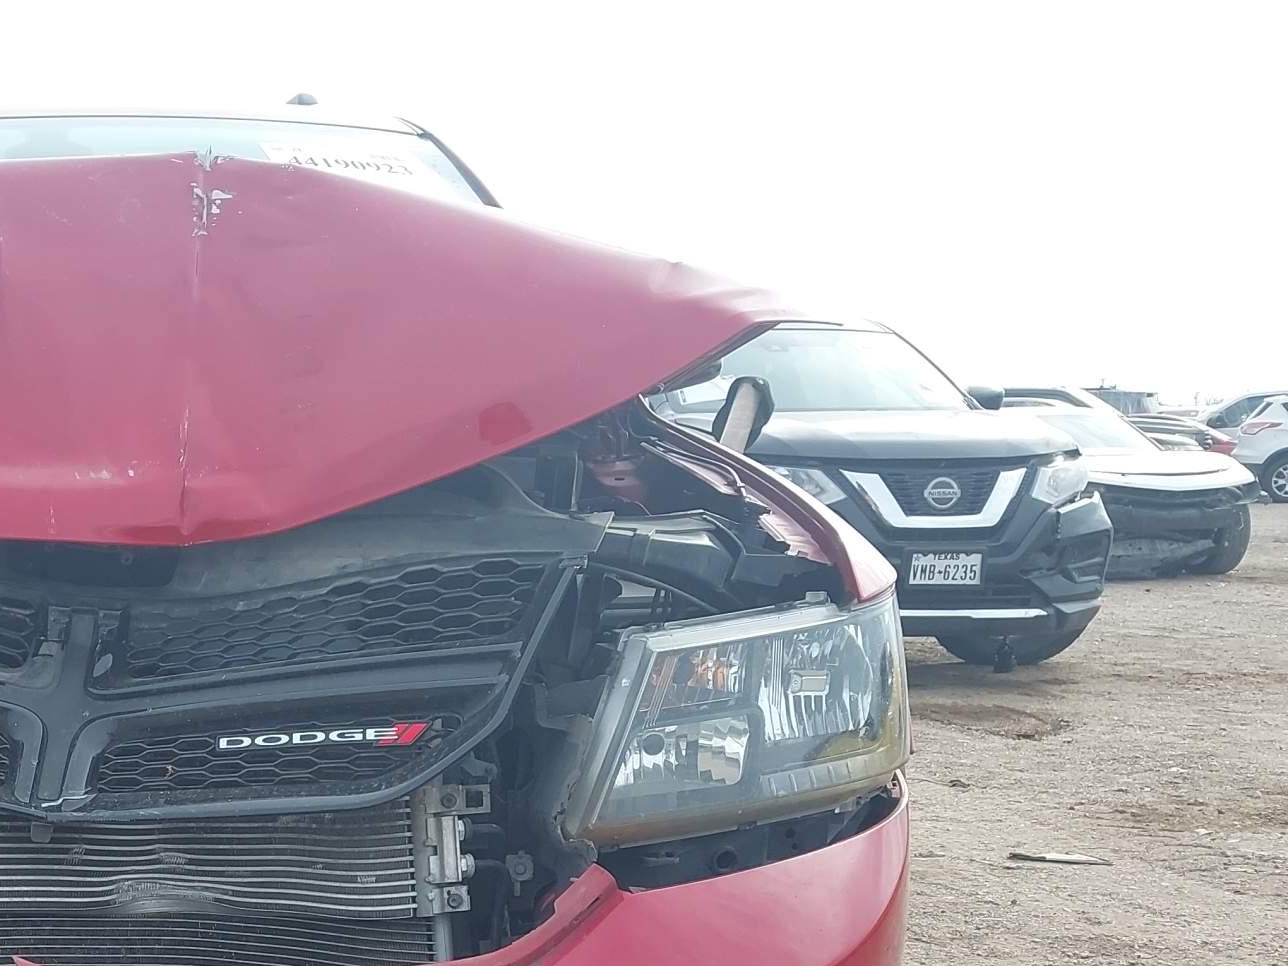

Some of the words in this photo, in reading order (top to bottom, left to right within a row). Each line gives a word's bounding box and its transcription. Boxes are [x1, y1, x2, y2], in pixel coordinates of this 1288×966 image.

[288, 155, 415, 176] 44190923
[928, 489, 958, 497] NISSAN
[932, 552, 961, 561] TEXAS
[218, 727, 399, 749] DODGE
